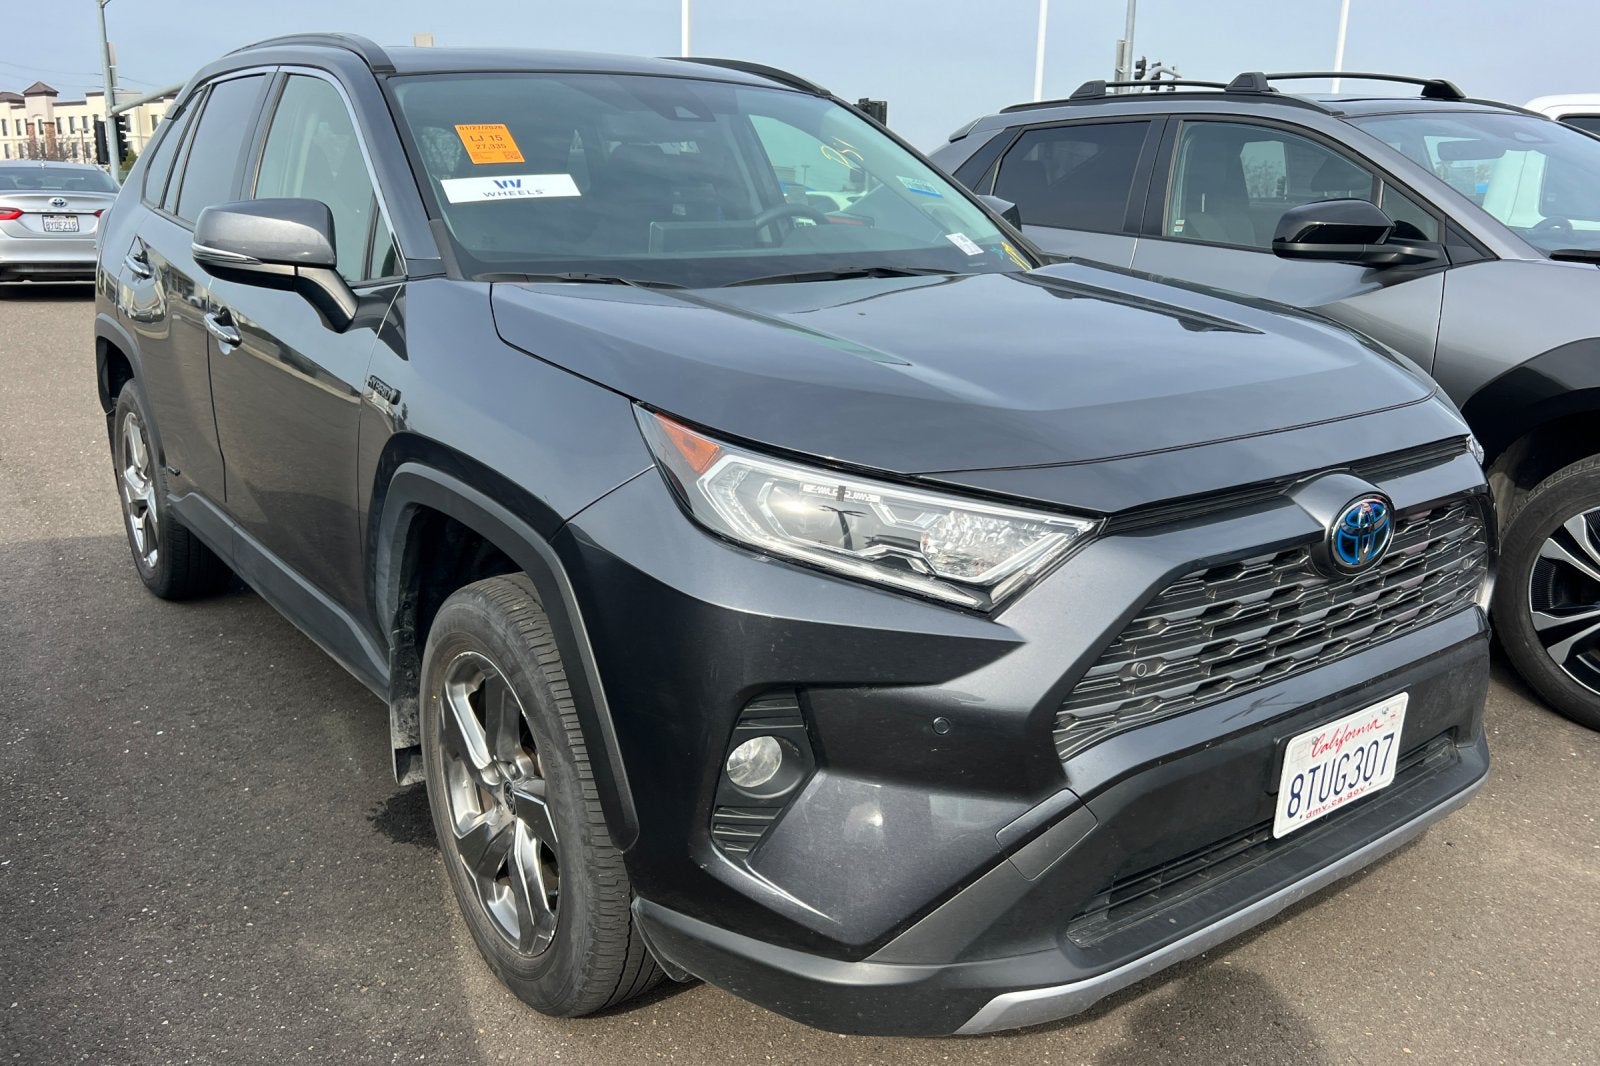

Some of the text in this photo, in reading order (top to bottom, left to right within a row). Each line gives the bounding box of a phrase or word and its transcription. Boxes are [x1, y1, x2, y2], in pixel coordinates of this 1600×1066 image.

[489, 134, 503, 142] 15
[483, 189, 544, 198] WHEELS
[1311, 718, 1385, 758] California
[1287, 732, 1395, 819] 8TUG307
[1305, 785, 1367, 819] dmv.ca.gov
